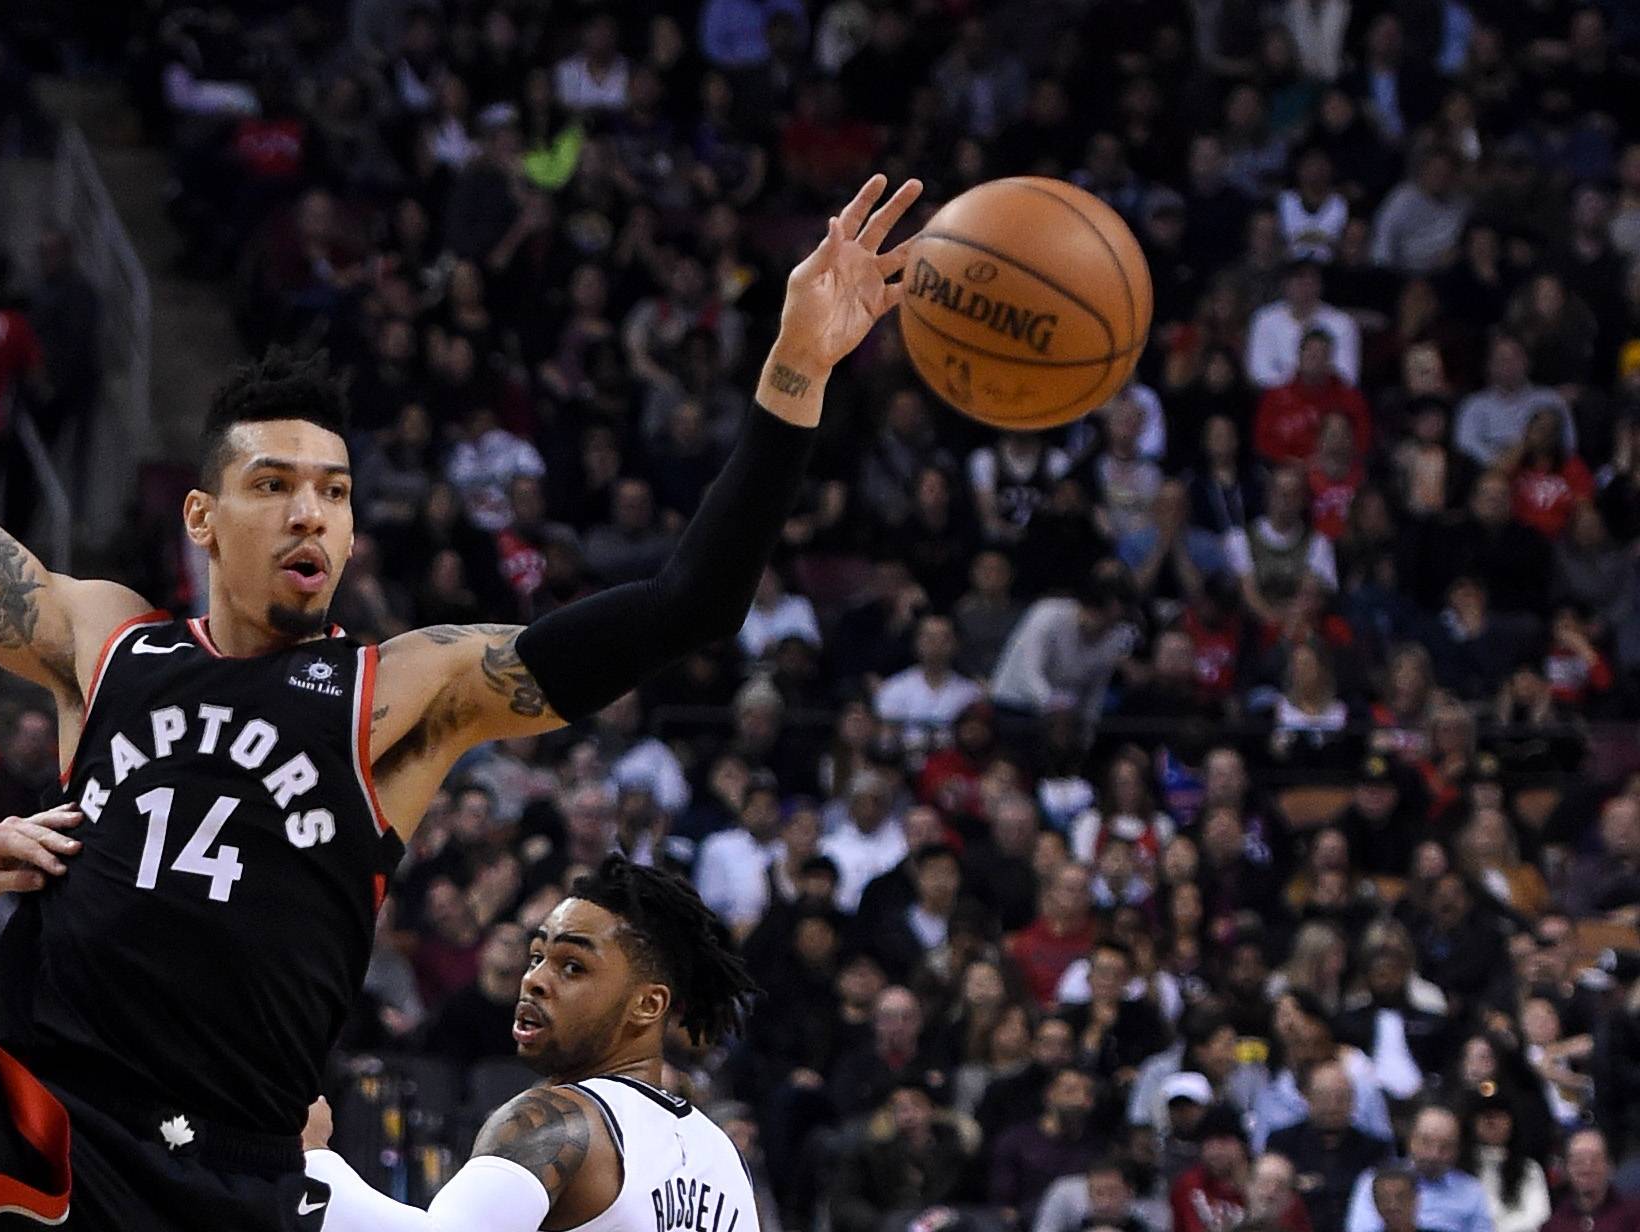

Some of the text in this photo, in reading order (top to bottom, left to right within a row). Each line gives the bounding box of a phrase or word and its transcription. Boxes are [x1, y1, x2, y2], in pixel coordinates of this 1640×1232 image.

[909, 257, 1059, 353] SPALDING
[288, 676, 343, 696] Sun Life
[79, 703, 336, 848] RAPTORS
[135, 787, 243, 902] 14
